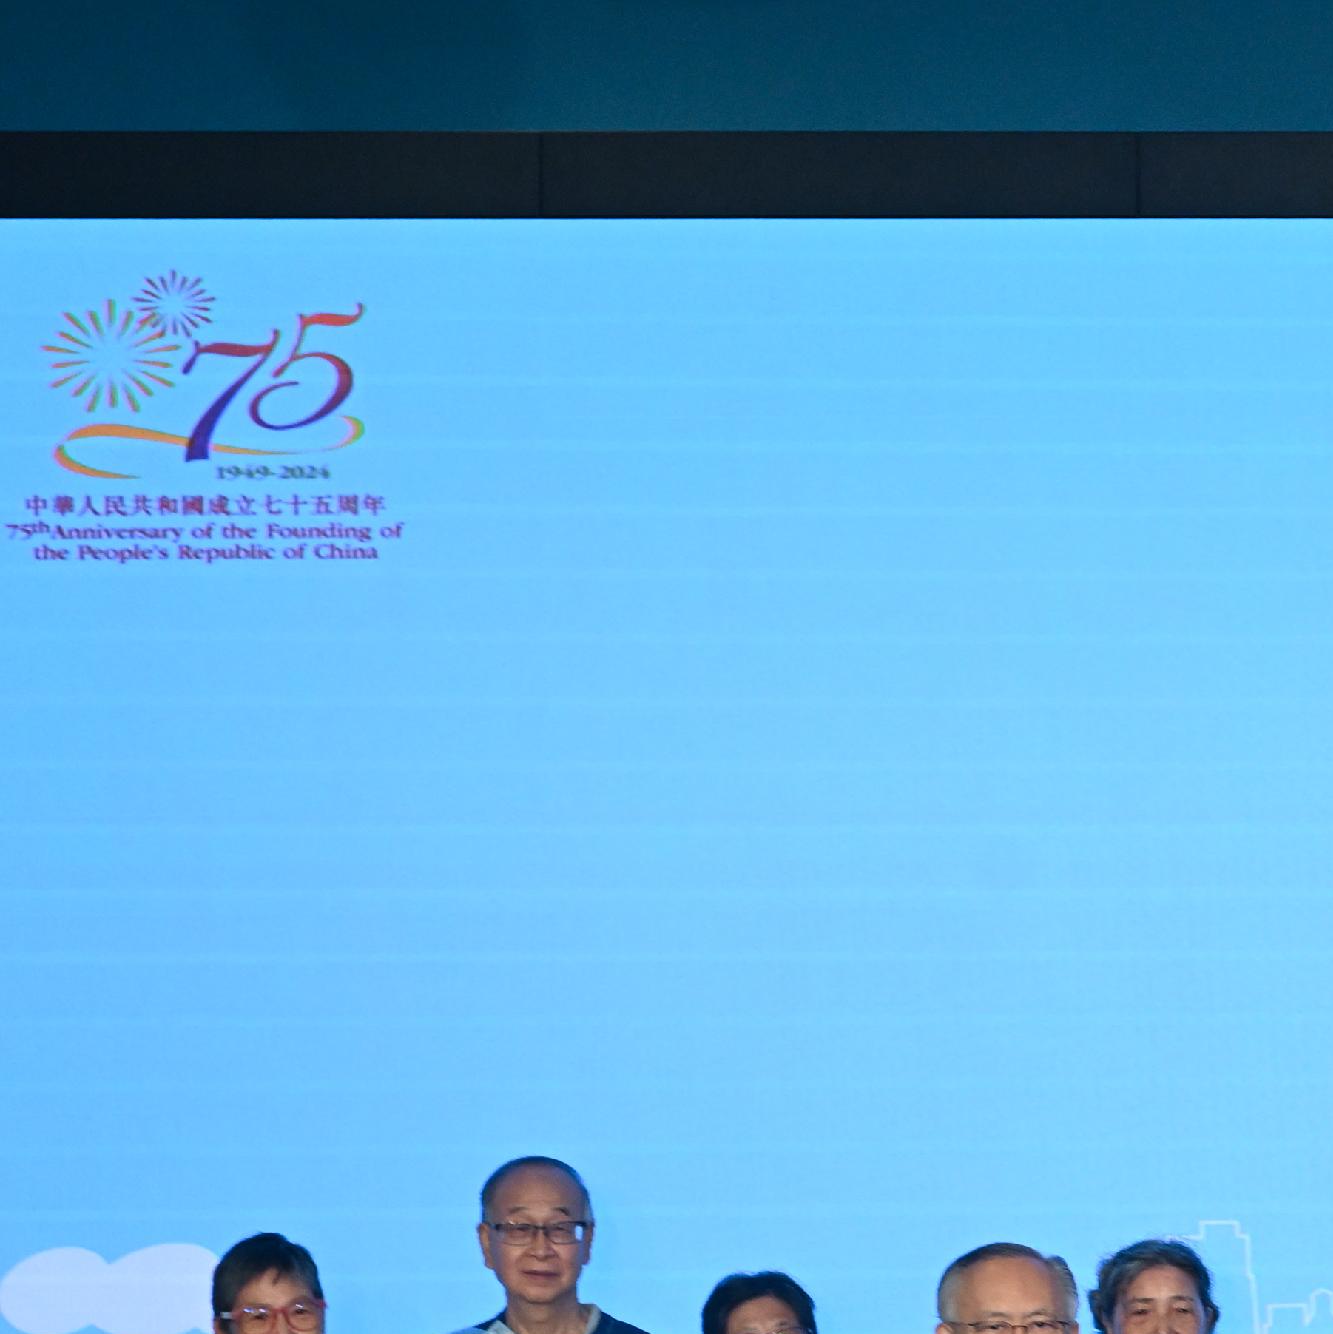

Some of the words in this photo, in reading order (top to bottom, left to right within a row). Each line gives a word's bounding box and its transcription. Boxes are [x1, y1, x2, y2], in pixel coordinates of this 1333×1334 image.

[182, 302, 366, 462] 75
[216, 464, 331, 481] 1949-2024
[25, 494, 386, 518] 中華人民共和國成立七十五周年
[52, 522, 182, 541] Anniversary
[190, 522, 215, 539] of
[221, 522, 257, 540] the
[267, 522, 372, 543] Founding
[380, 523, 403, 540] of
[34, 544, 70, 561] the
[78, 544, 170, 564] People's
[178, 544, 274, 564] Republic
[282, 543, 307, 560] of
[313, 543, 380, 560] China
